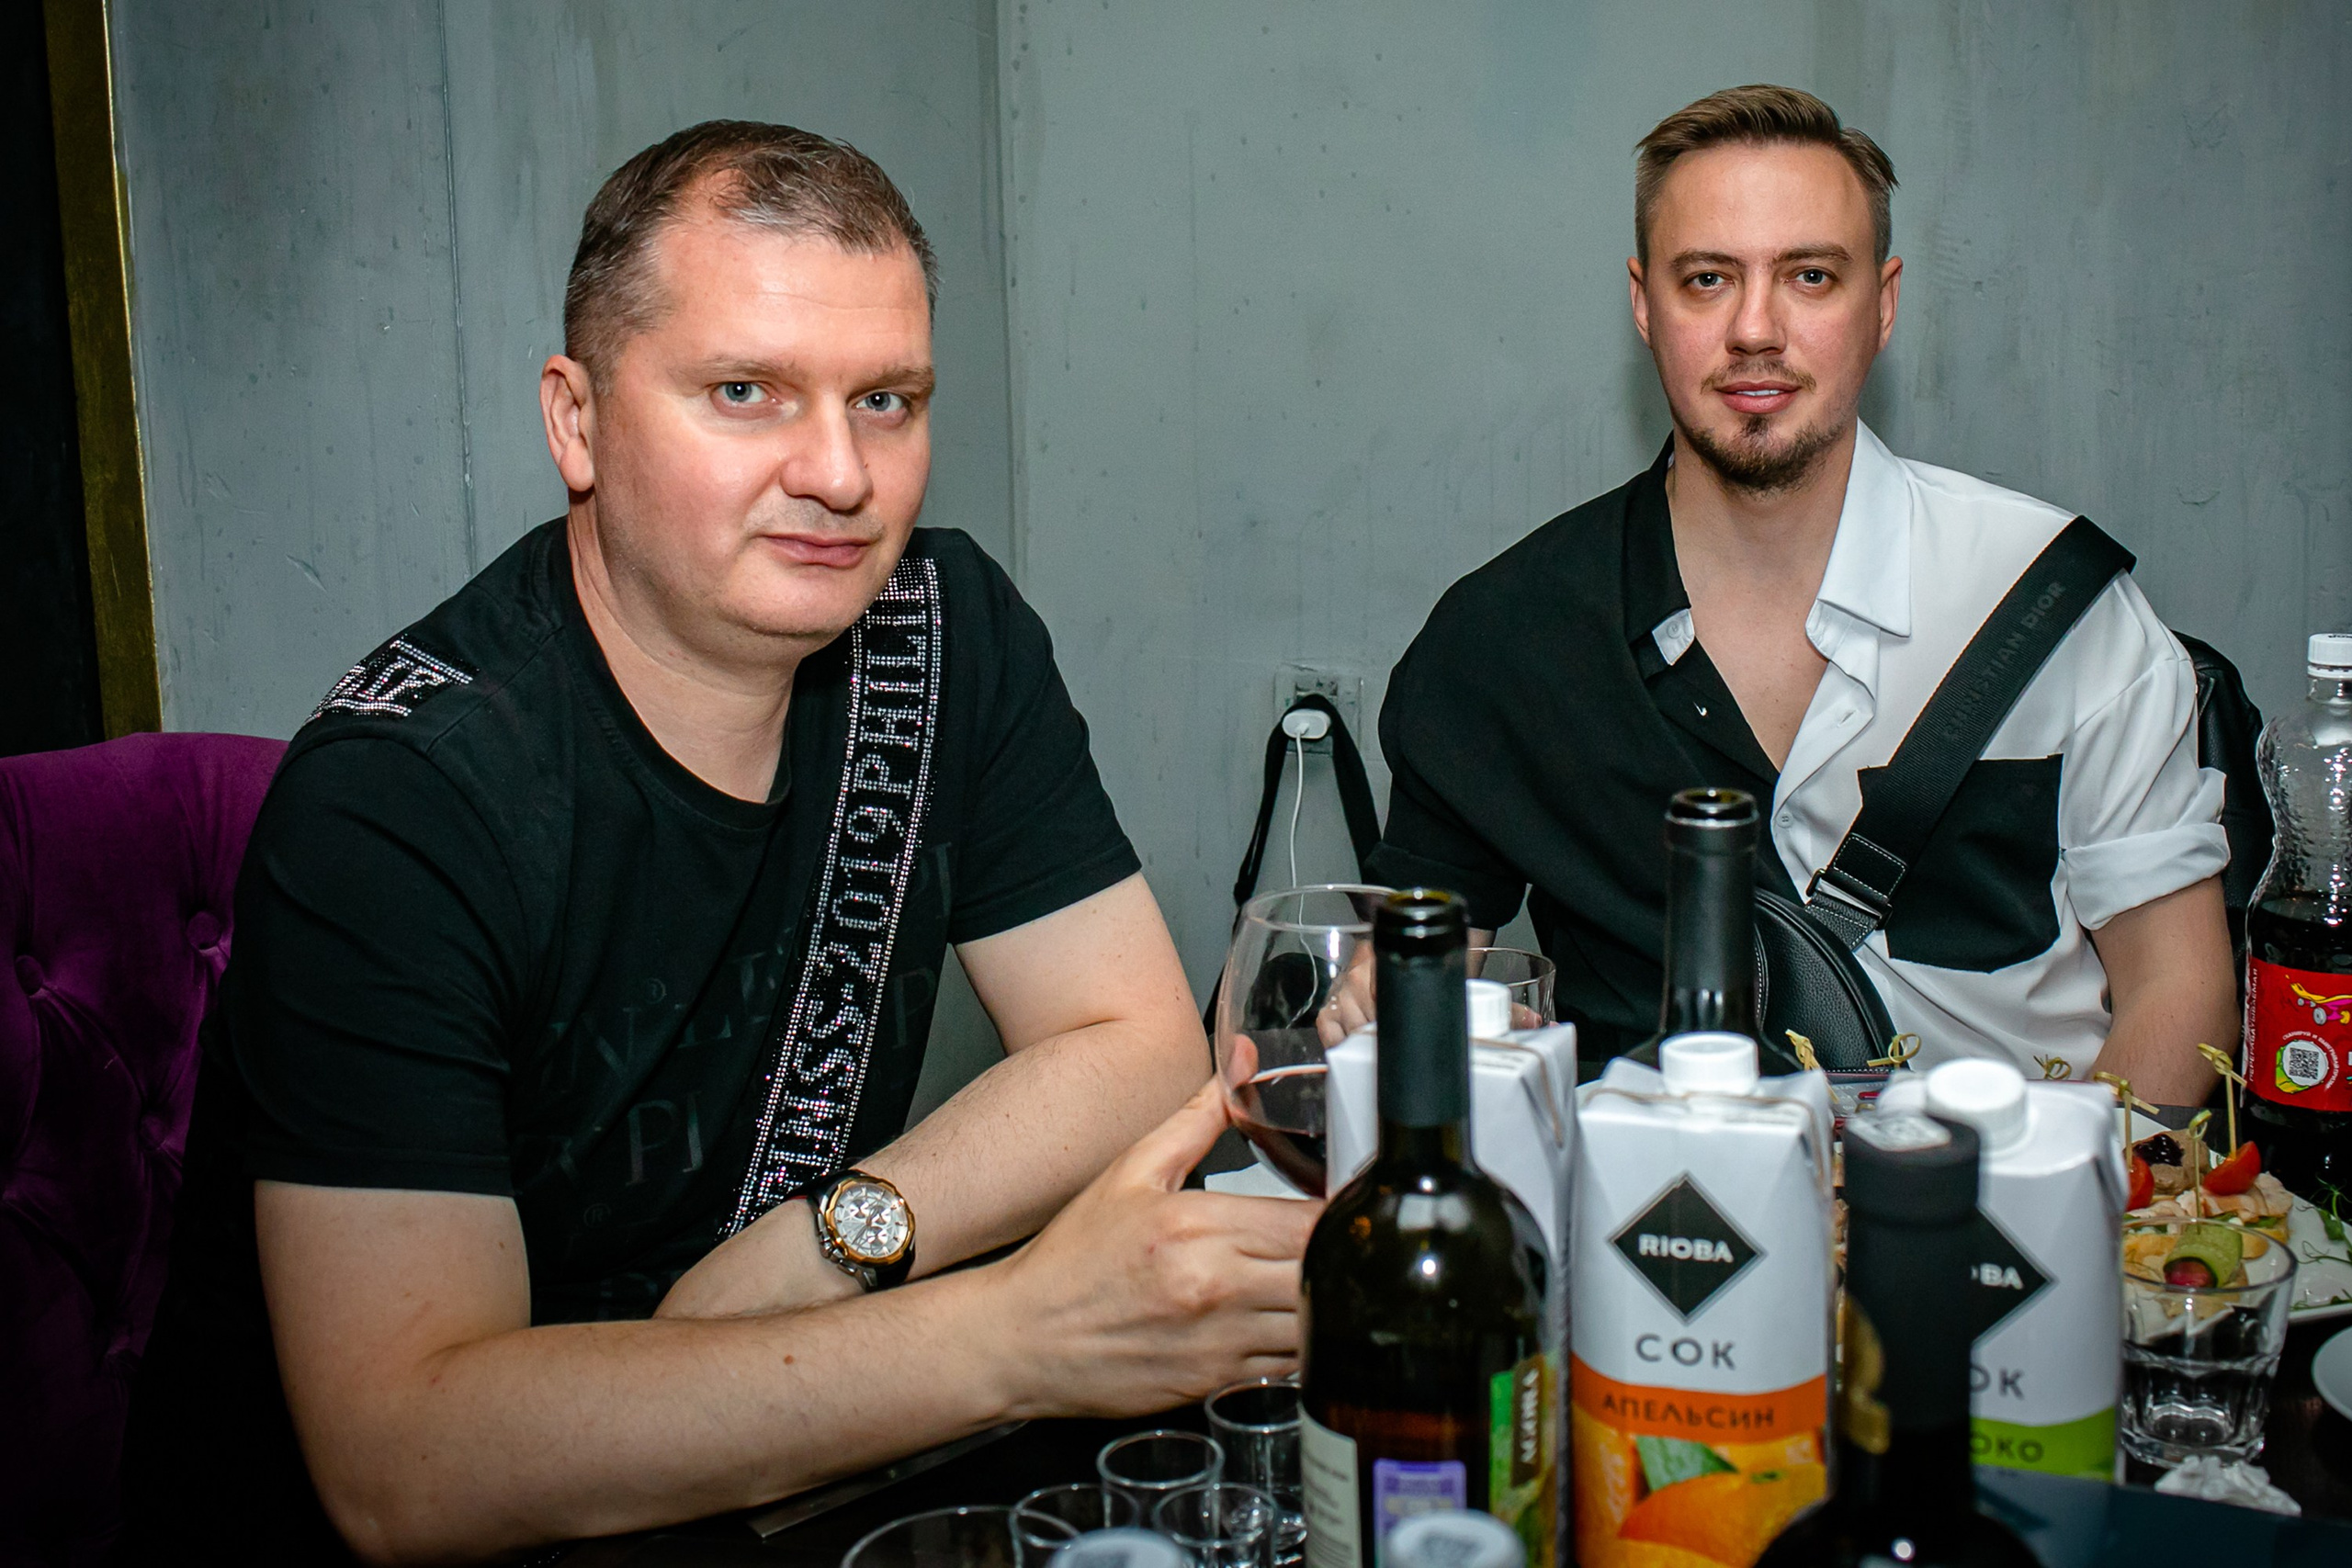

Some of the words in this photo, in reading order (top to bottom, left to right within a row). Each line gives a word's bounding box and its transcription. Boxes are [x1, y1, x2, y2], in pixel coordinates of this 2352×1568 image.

[1940, 631, 2027, 742] CHRISTIAN
[2021, 581, 2065, 629] DIOR
[1638, 1233, 1734, 1264] RIOBA
[1635, 1332, 1736, 1371] СОК
[1601, 1392, 1776, 1430] АПЕЛЬСИН
